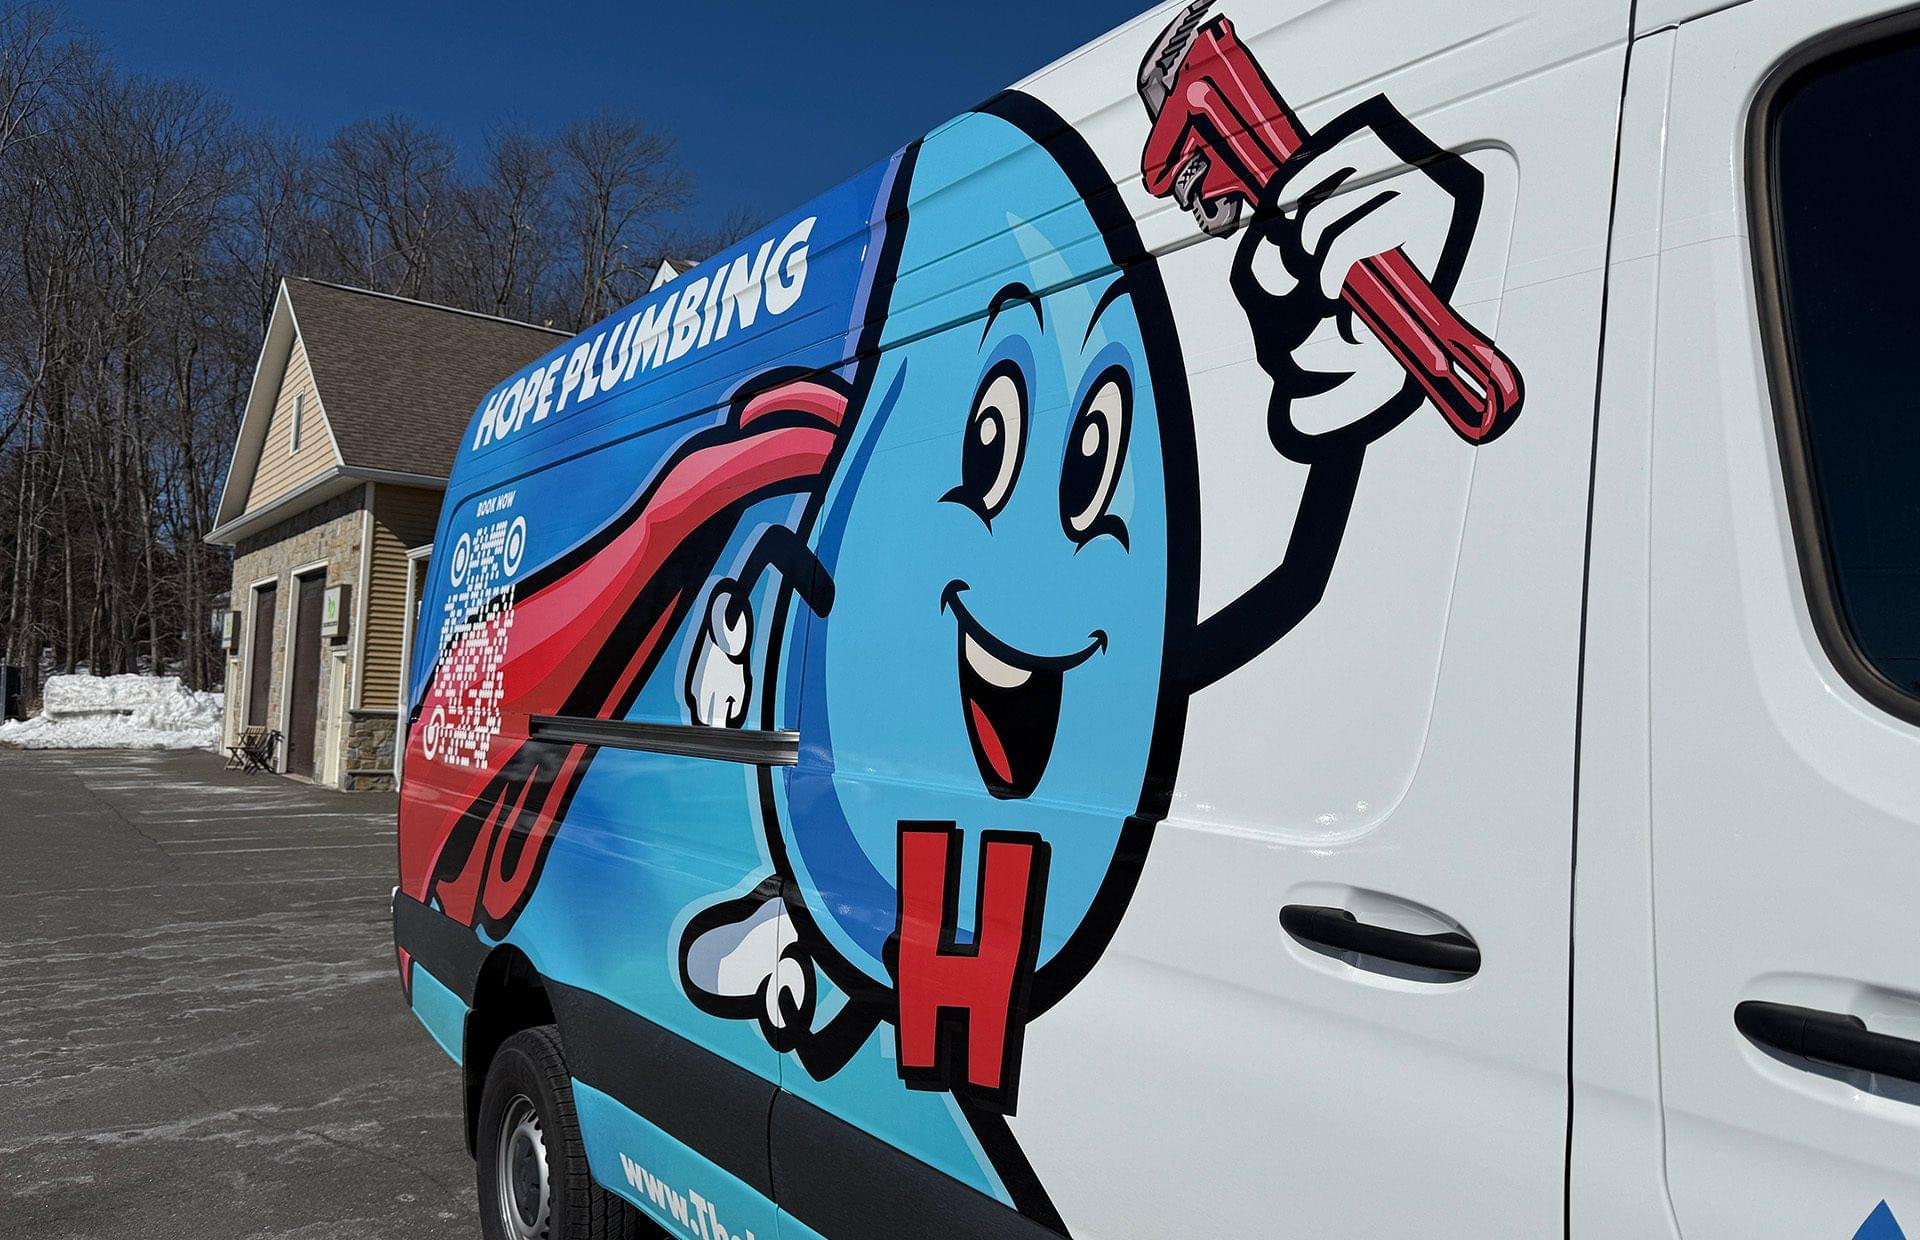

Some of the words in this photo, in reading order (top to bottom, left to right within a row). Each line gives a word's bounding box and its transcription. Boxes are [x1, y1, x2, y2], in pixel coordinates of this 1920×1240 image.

[472, 354, 567, 451] HOPE
[556, 216, 817, 413] PLUMBING
[476, 497, 498, 518] BOOK
[496, 490, 517, 512] NOW
[896, 821, 1047, 1108] H
[619, 1152, 755, 1240] www.Th
